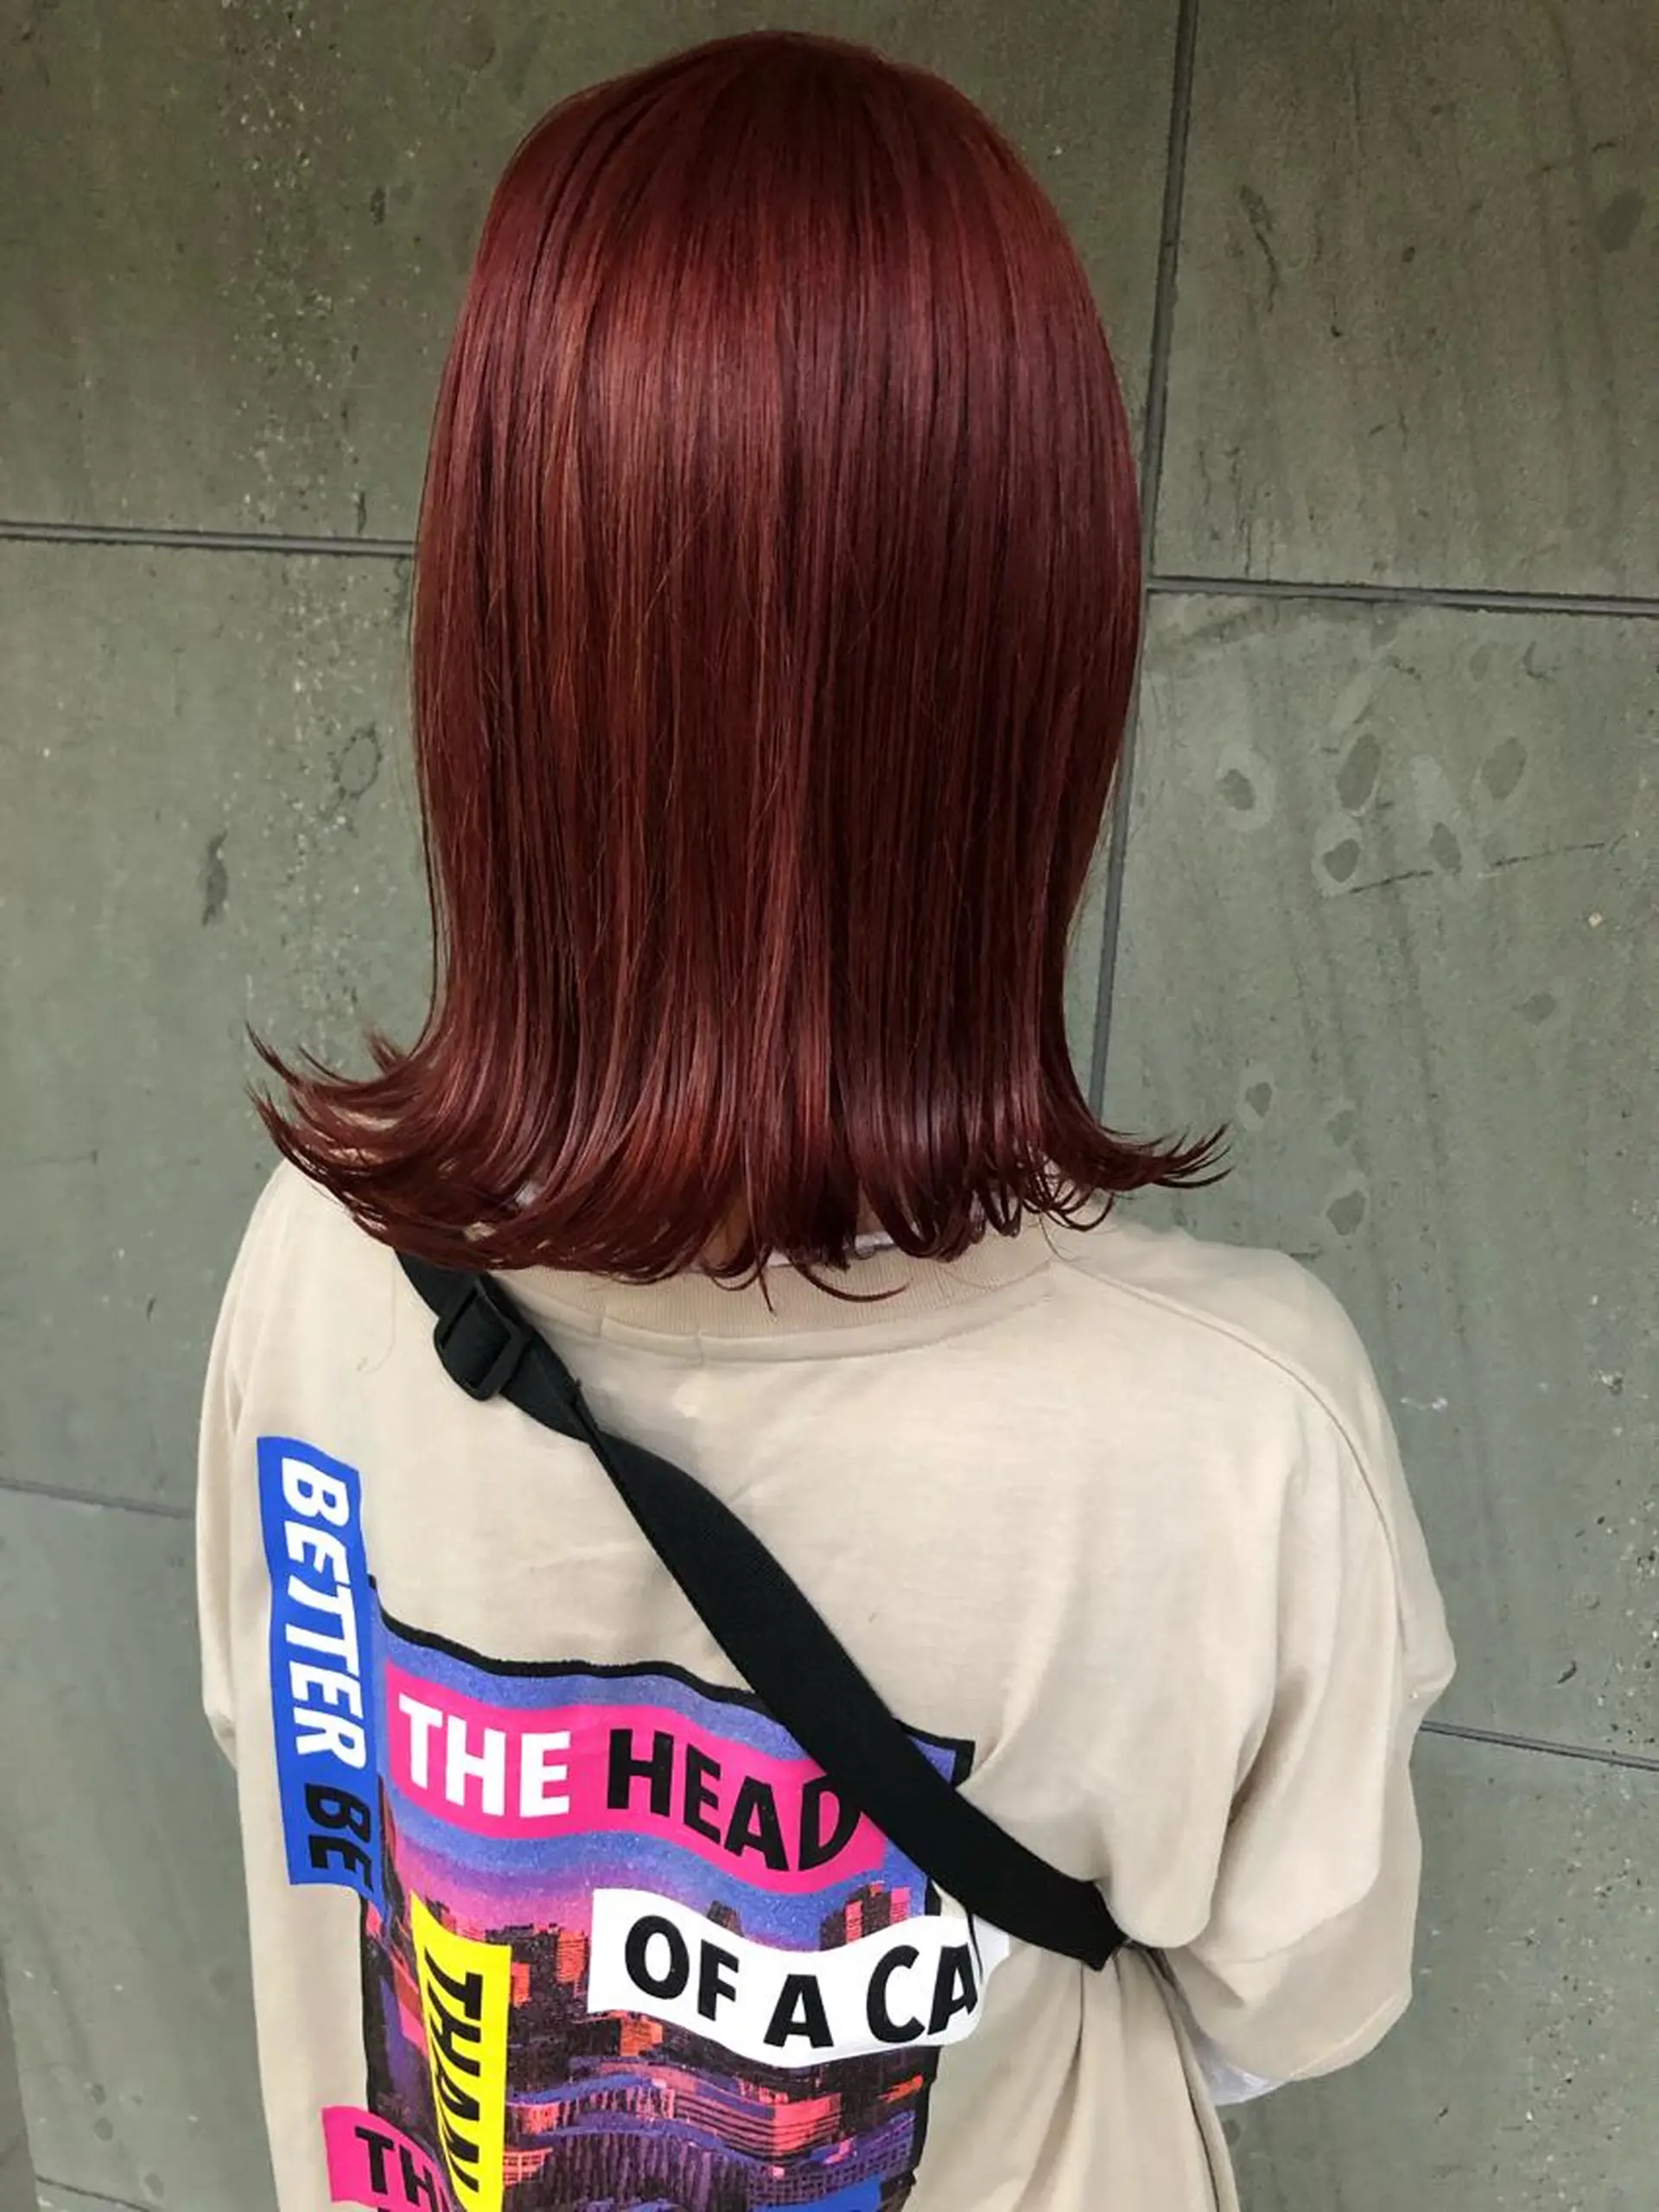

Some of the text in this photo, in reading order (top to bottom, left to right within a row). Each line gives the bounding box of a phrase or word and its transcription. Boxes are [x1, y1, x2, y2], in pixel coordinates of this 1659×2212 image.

[281, 1457, 374, 1894] BETTER BE
[398, 1693, 862, 1872] THE HEAD
[625, 1915, 740, 2022] OF
[764, 1974, 834, 2049] A
[355, 2125, 452, 2212] TH
